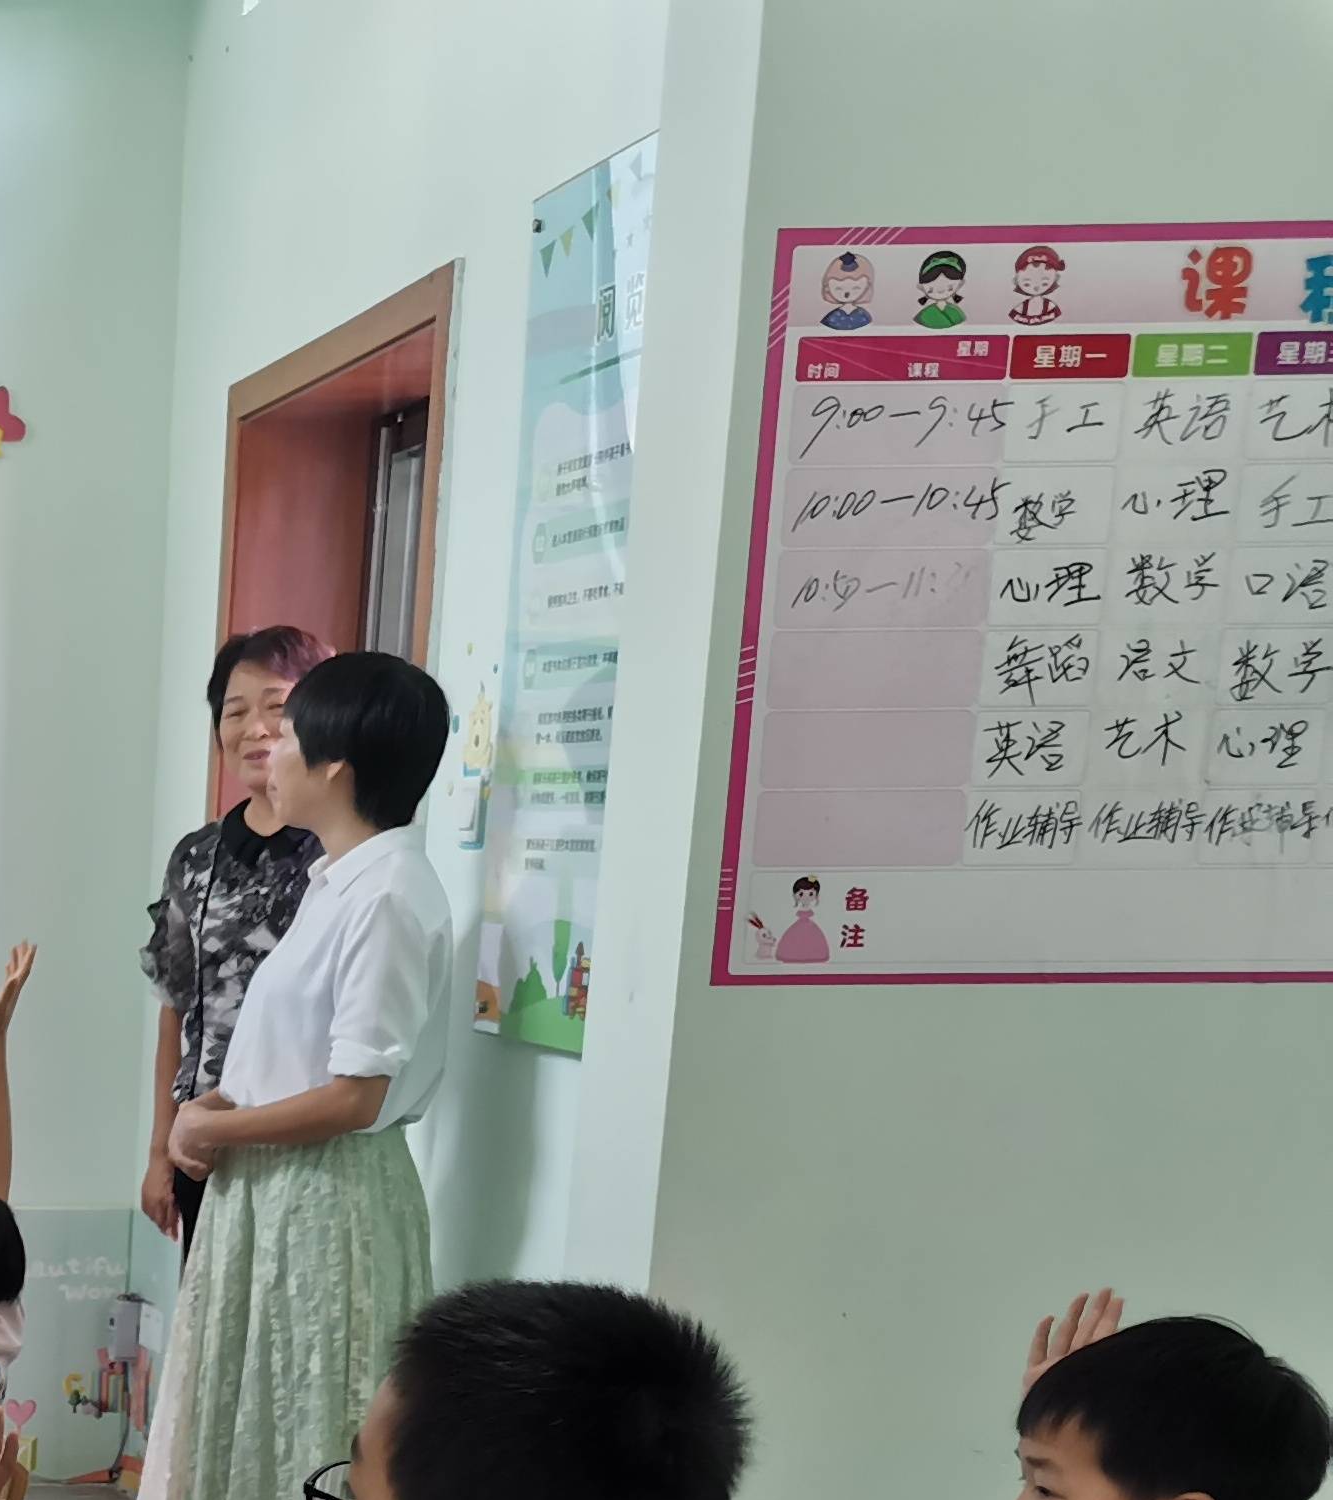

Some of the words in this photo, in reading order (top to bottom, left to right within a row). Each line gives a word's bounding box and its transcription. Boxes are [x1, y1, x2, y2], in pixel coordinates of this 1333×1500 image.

[806, 362, 840, 379] 时间
[908, 362, 940, 379] 课程
[956, 341, 989, 357] 星期
[1033, 345, 1107, 368] 星期一
[1155, 343, 1229, 367] 星期二
[1027, 393, 1106, 440] 手工
[1133, 387, 1233, 446] 英语
[1009, 489, 1078, 543] 数学
[1120, 468, 1231, 521] 心理
[998, 561, 1101, 607] 心理
[1124, 551, 1221, 606] 数学
[1245, 558, 1333, 610] 口语
[993, 633, 1090, 707] 舞蹈
[1117, 638, 1203, 684] 语文
[1229, 637, 1333, 702] 数学
[983, 718, 1068, 778] 英语
[1104, 709, 1188, 766] 艺术
[1217, 719, 1309, 769] 心理
[966, 798, 1083, 850] 作业辅导
[1088, 799, 1207, 845] 作业辅导
[840, 887, 870, 949] 备注
